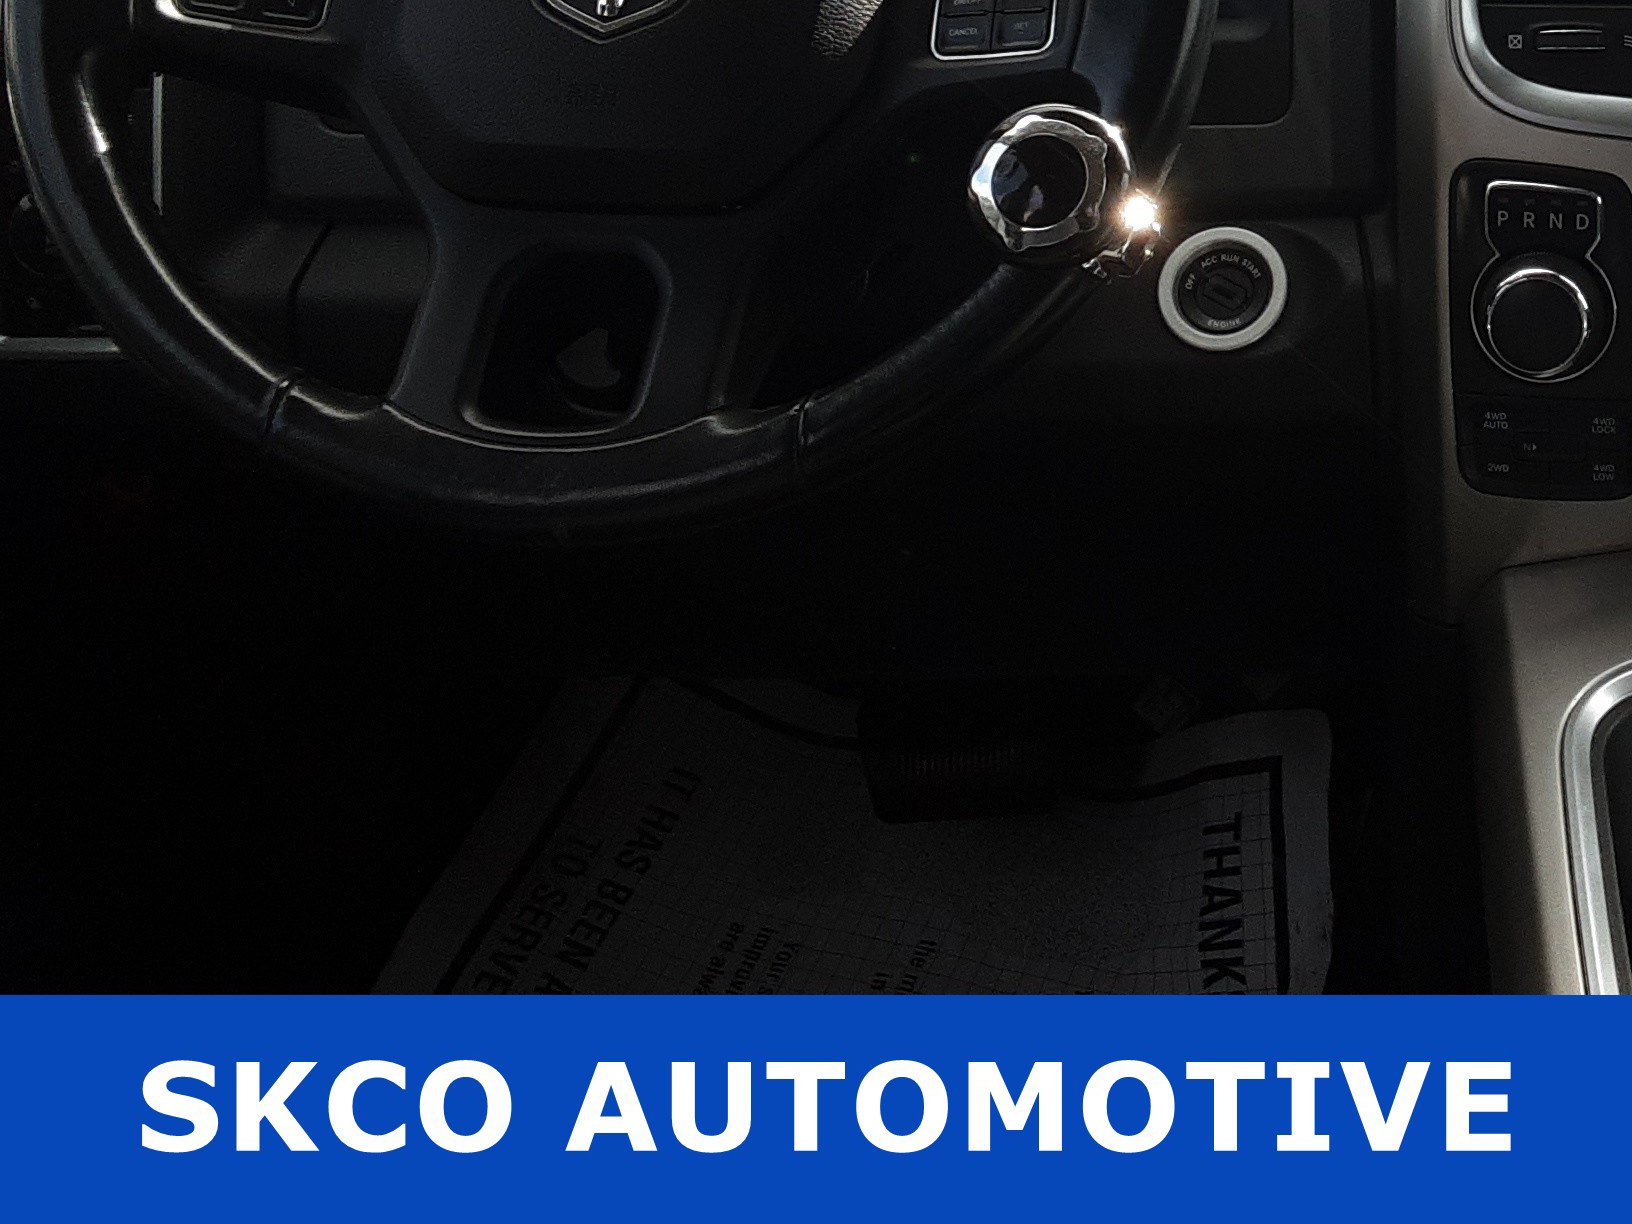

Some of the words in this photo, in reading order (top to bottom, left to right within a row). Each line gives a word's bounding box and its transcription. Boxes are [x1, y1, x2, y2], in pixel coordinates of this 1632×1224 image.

[1497, 210, 1509, 226] P
[1523, 212, 1535, 229] R
[1549, 212, 1563, 230] N
[1575, 213, 1589, 230] D
[1200, 256, 1218, 269] ACC
[1220, 253, 1240, 263] RUN
[1241, 257, 1262, 279] START
[1207, 317, 1242, 328] ENGINE
[1483, 421, 1509, 430] AUTO
[1484, 411, 1507, 421] 4WD
[550, 834, 604, 878] TO
[615, 805, 681, 875] HAS
[1200, 811, 1248, 993] THANK
[472, 883, 569, 993] SERVE
[556, 878, 634, 971] BEEN
[719, 922, 745, 952] are
[765, 942, 801, 979] Your
